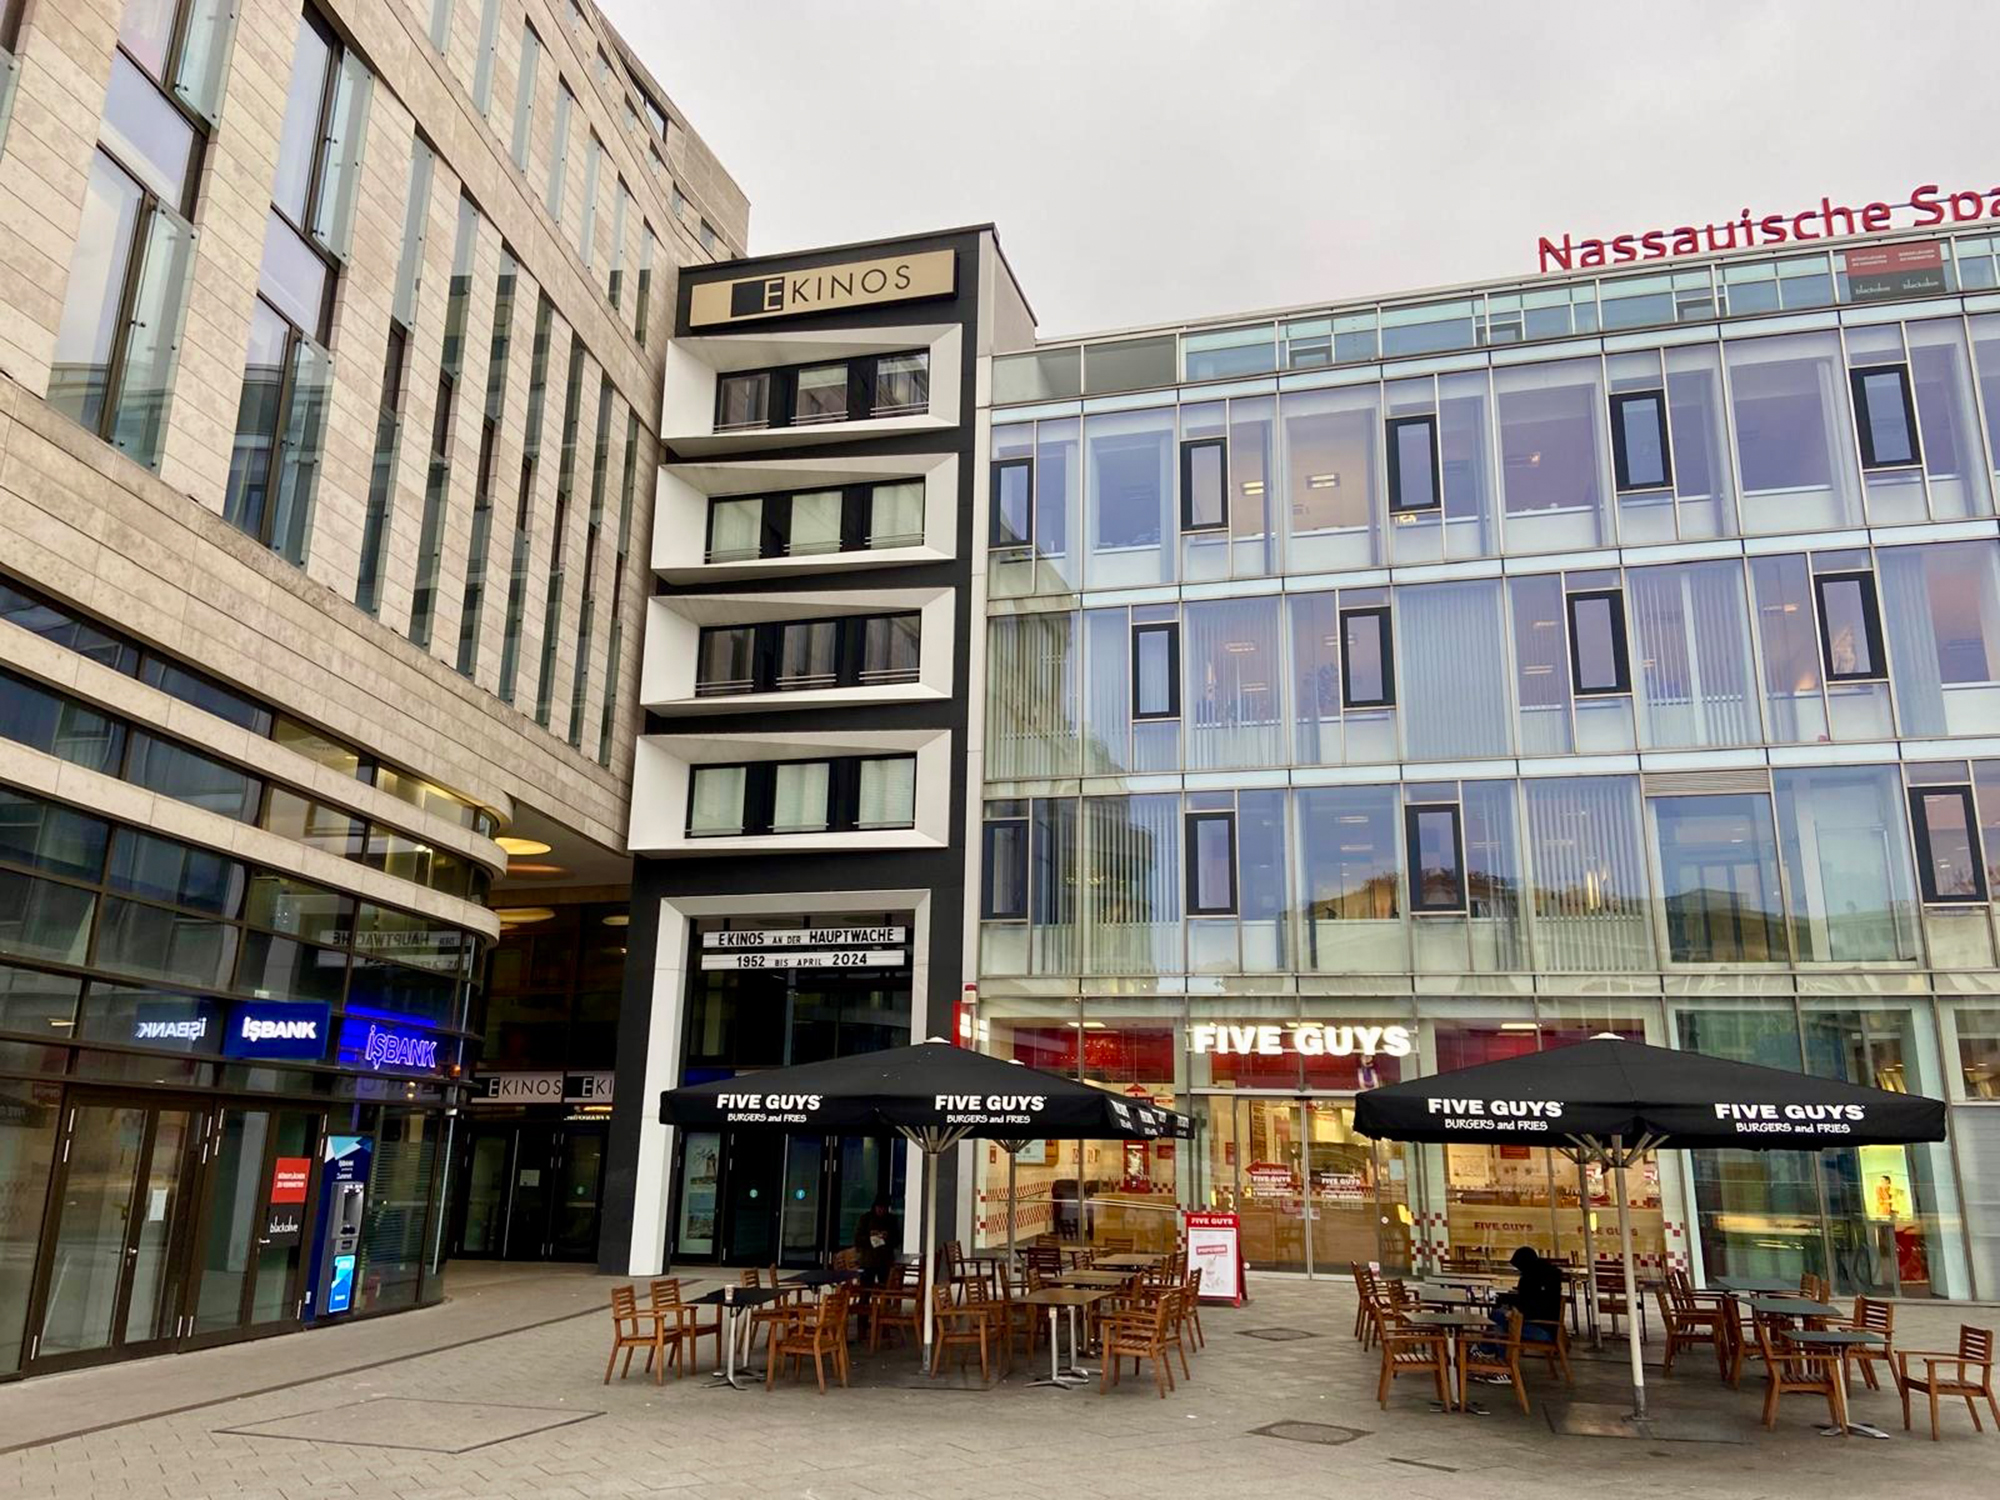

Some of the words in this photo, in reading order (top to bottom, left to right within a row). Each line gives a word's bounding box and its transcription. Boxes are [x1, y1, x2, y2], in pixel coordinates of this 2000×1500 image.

[1538, 197, 1892, 273] Nassauische
[772, 936, 783, 944] AN
[787, 936, 801, 944] DER
[809, 928, 894, 944] HAUPTWACHE
[737, 955, 765, 968] 1952
[775, 958, 788, 966] BIS
[797, 958, 822, 967] APRIL
[832, 953, 867, 966] 2024
[1193, 1025, 1283, 1055] FIVE
[1294, 1026, 1411, 1057] GUYS
[716, 1093, 762, 1109] FIVE
[765, 1093, 821, 1111] GUYS
[934, 1095, 982, 1111] FIVE
[986, 1095, 1045, 1112] GUYS
[1428, 1098, 1485, 1115] FIVE
[1490, 1100, 1562, 1118] GUYS
[727, 1113, 767, 1122] BURGERS
[767, 1114, 782, 1122] and
[783, 1114, 807, 1123] FRIES
[946, 1114, 988, 1124] BURGERS
[989, 1115, 1004, 1124] and
[1005, 1115, 1031, 1124] FRIES
[1714, 1103, 1779, 1120] FIVE
[1784, 1104, 1865, 1121] GUYS
[1444, 1118, 1495, 1129] BURGERS
[1497, 1120, 1515, 1130] and
[1517, 1120, 1548, 1131] FRIES
[1735, 1122, 1792, 1133] BURGERS
[1794, 1123, 1814, 1133] and
[1816, 1123, 1850, 1134] FRIES
[1211, 1217, 1234, 1225] GUYS
[1474, 1222, 1500, 1231] FIVE
[1502, 1223, 1534, 1232] GUYS
[1577, 1226, 1603, 1235] FE
[1606, 1227, 1638, 1237] GUS
